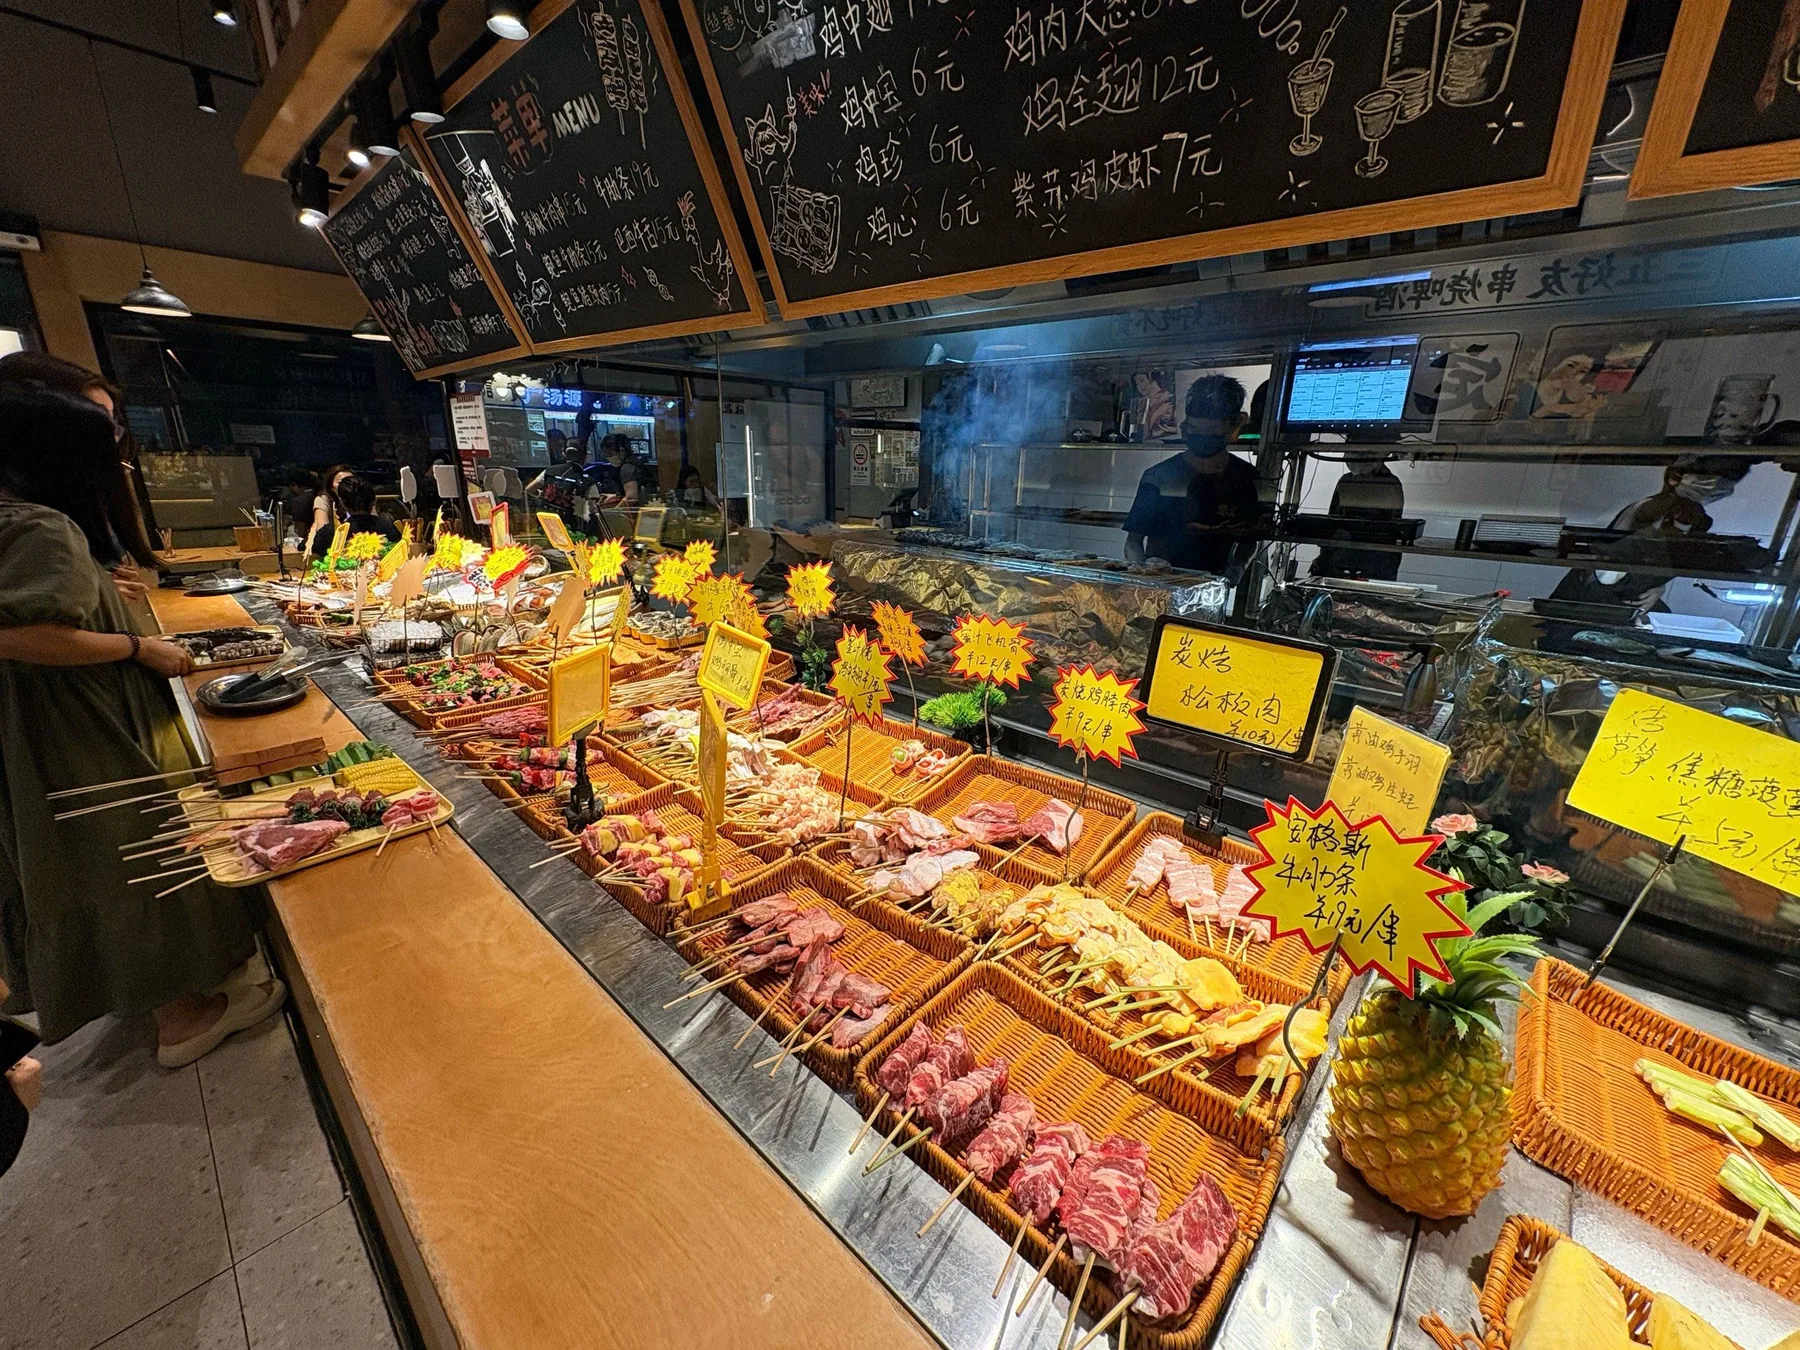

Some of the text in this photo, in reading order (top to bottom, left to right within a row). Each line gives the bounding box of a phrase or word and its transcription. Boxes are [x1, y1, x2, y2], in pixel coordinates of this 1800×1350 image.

[819, 0, 893, 59] 鸡中翅
[912, 47, 965, 97] 6元
[552, 92, 601, 139] MENU
[855, 124, 974, 187] 鸡珍 6元
[867, 188, 980, 246] 鸡心 6元
[1287, 812, 1371, 871] 安格斯
